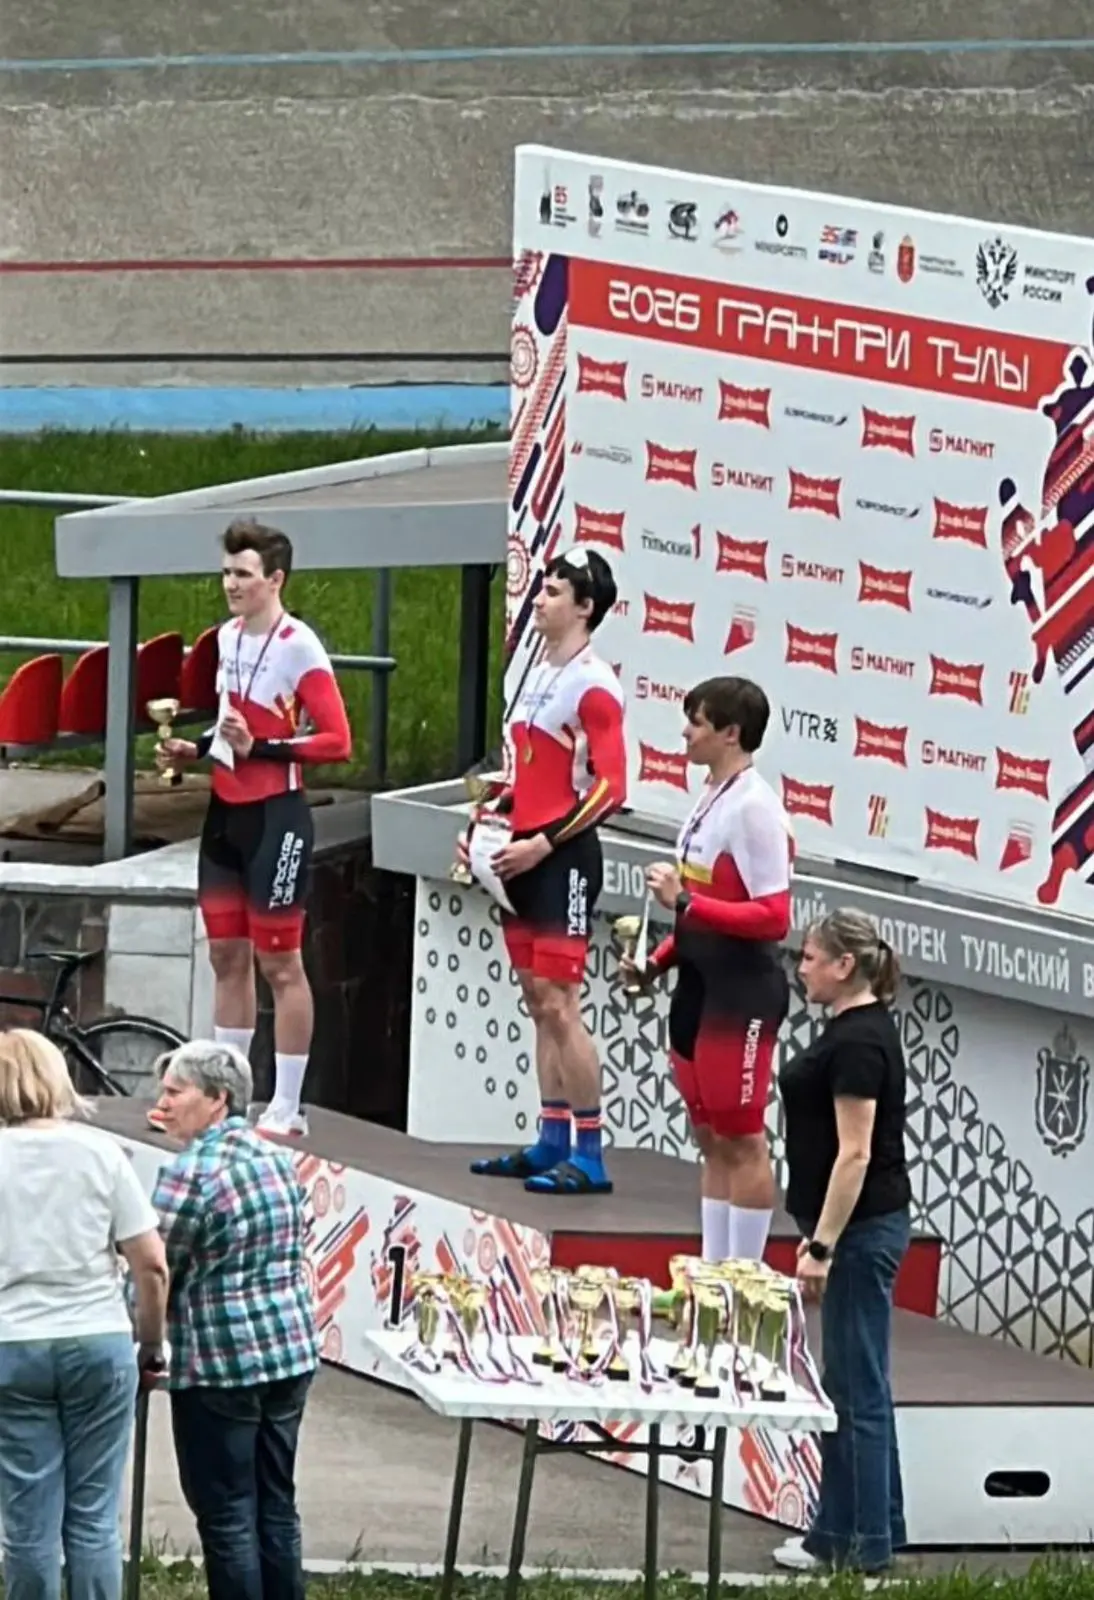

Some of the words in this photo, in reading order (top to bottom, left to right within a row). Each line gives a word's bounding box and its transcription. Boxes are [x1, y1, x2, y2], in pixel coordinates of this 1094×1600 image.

[1024, 265, 1077, 285] МИНСПОРТ
[1023, 284, 1063, 303] РОССИИ
[608, 279, 700, 331] 2026
[717, 297, 911, 371] ГРАН-ПРИ
[926, 335, 1029, 392] ТУЛЫ
[656, 379, 703, 403] МАГНИТ
[944, 435, 995, 458] МАГНИТ
[726, 470, 774, 493] МАГНИТ
[796, 561, 844, 584] МАГНИТ
[866, 652, 916, 677] МАГНИТ
[651, 682, 687, 702] МАГН
[781, 707, 821, 740] VTR
[937, 749, 987, 772] МАГНИТ
[868, 914, 948, 964] ОТРЕК
[960, 935, 1070, 993] ТУЛЬСКИЙ
[743, 1018, 762, 1068] REGION
[388, 1245, 405, 1326] 1
